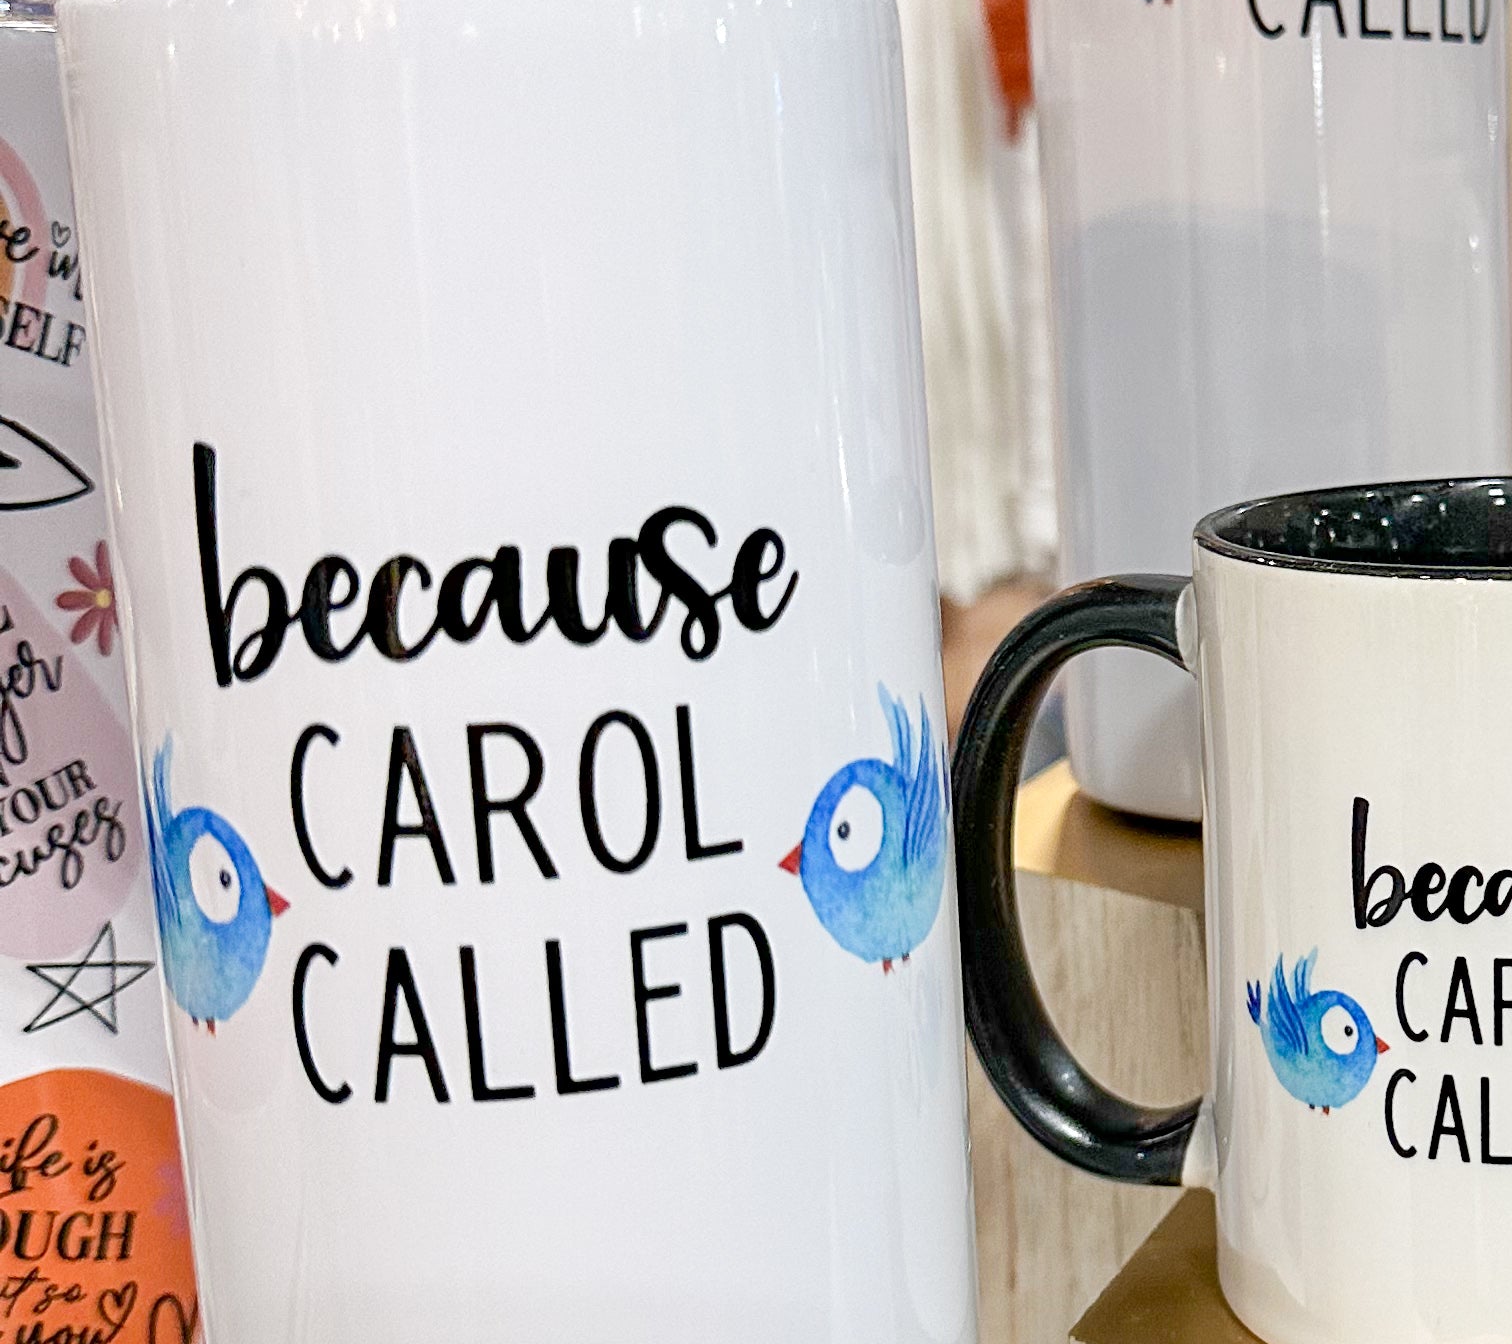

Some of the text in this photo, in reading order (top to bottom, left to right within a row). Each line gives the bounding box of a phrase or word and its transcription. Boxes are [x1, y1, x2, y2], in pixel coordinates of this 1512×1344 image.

[192, 441, 800, 688] because
[289, 704, 744, 891] CAROL
[291, 911, 777, 1106] CALLED
